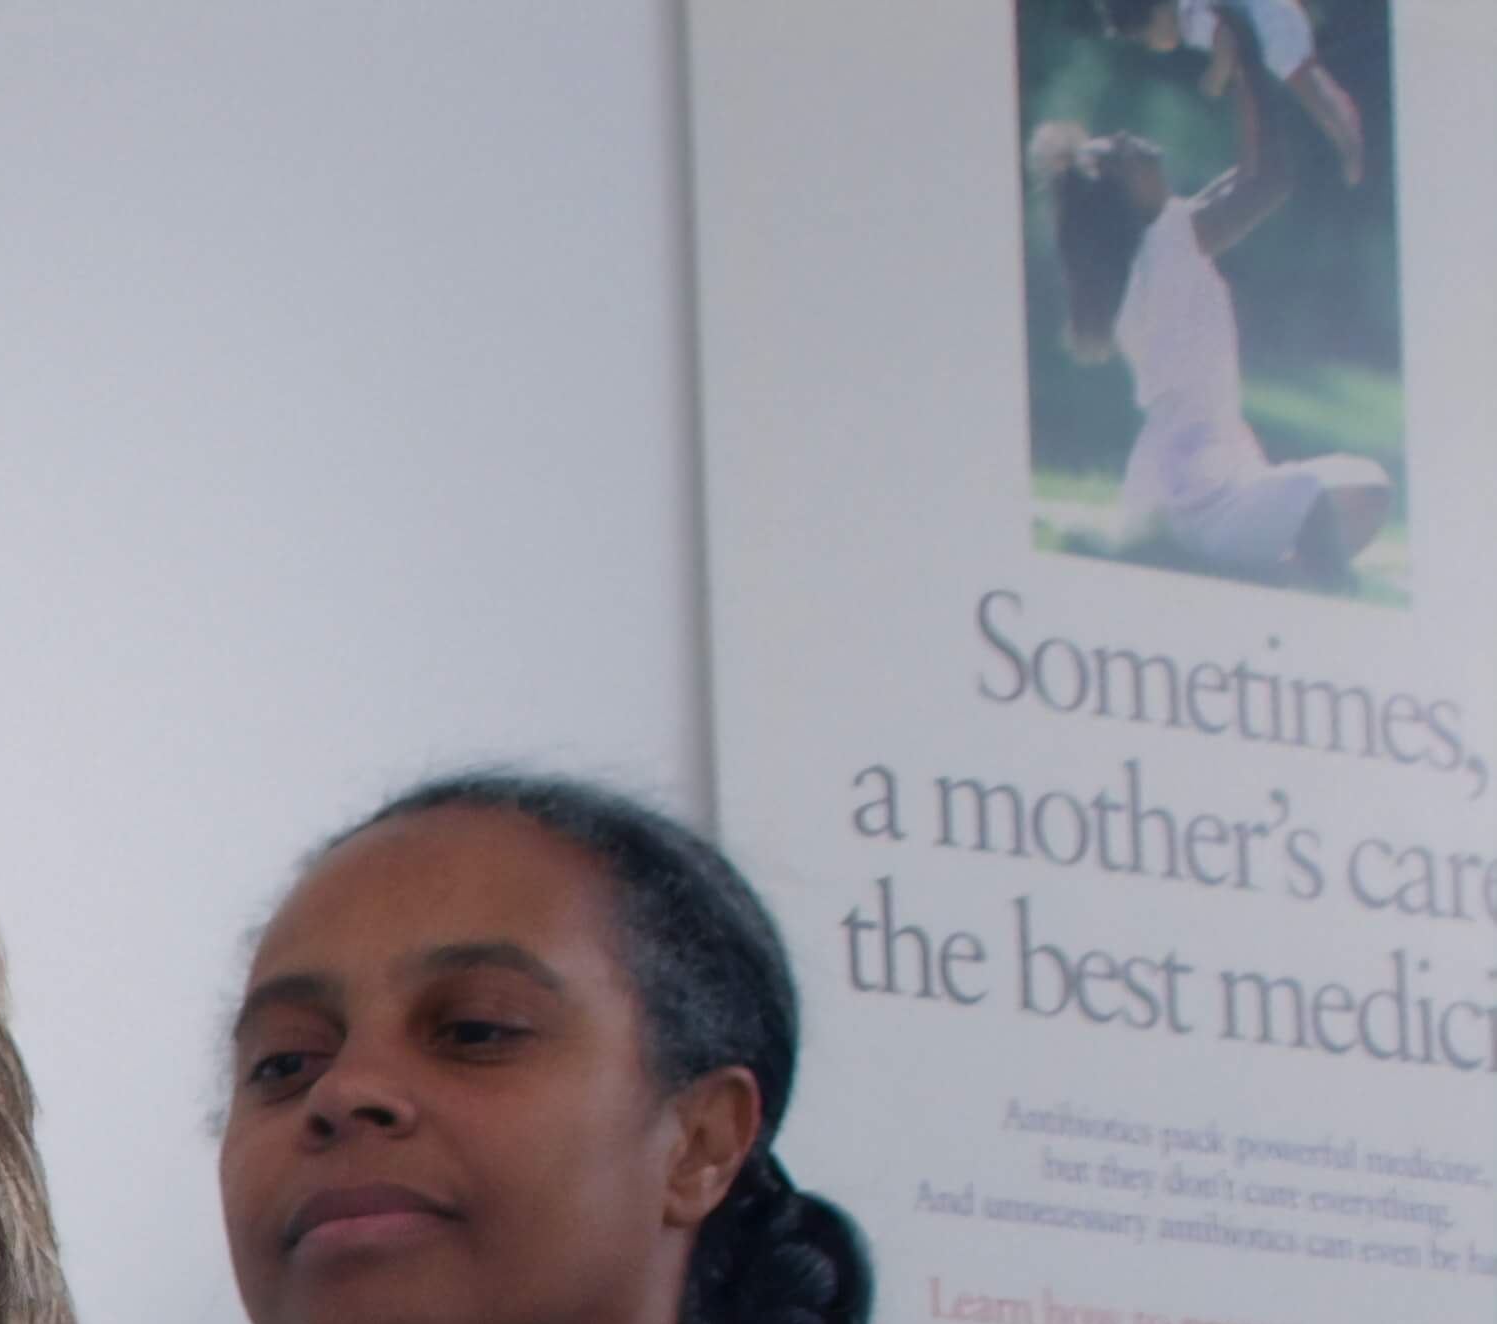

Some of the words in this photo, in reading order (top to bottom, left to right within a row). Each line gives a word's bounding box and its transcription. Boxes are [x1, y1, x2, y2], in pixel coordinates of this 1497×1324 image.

[975, 588, 1489, 801] Sometimes,
[851, 762, 907, 843] a
[841, 874, 989, 1006] the
[1014, 895, 1196, 1036] best
[1219, 948, 1497, 1073] medici
[1044, 1144, 1090, 1184] but
[1097, 1154, 1158, 1199] they
[1235, 1132, 1357, 1169] powerful
[914, 1178, 974, 1217] And
[1308, 1234, 1351, 1260] can
[1359, 1242, 1422, 1267] even
